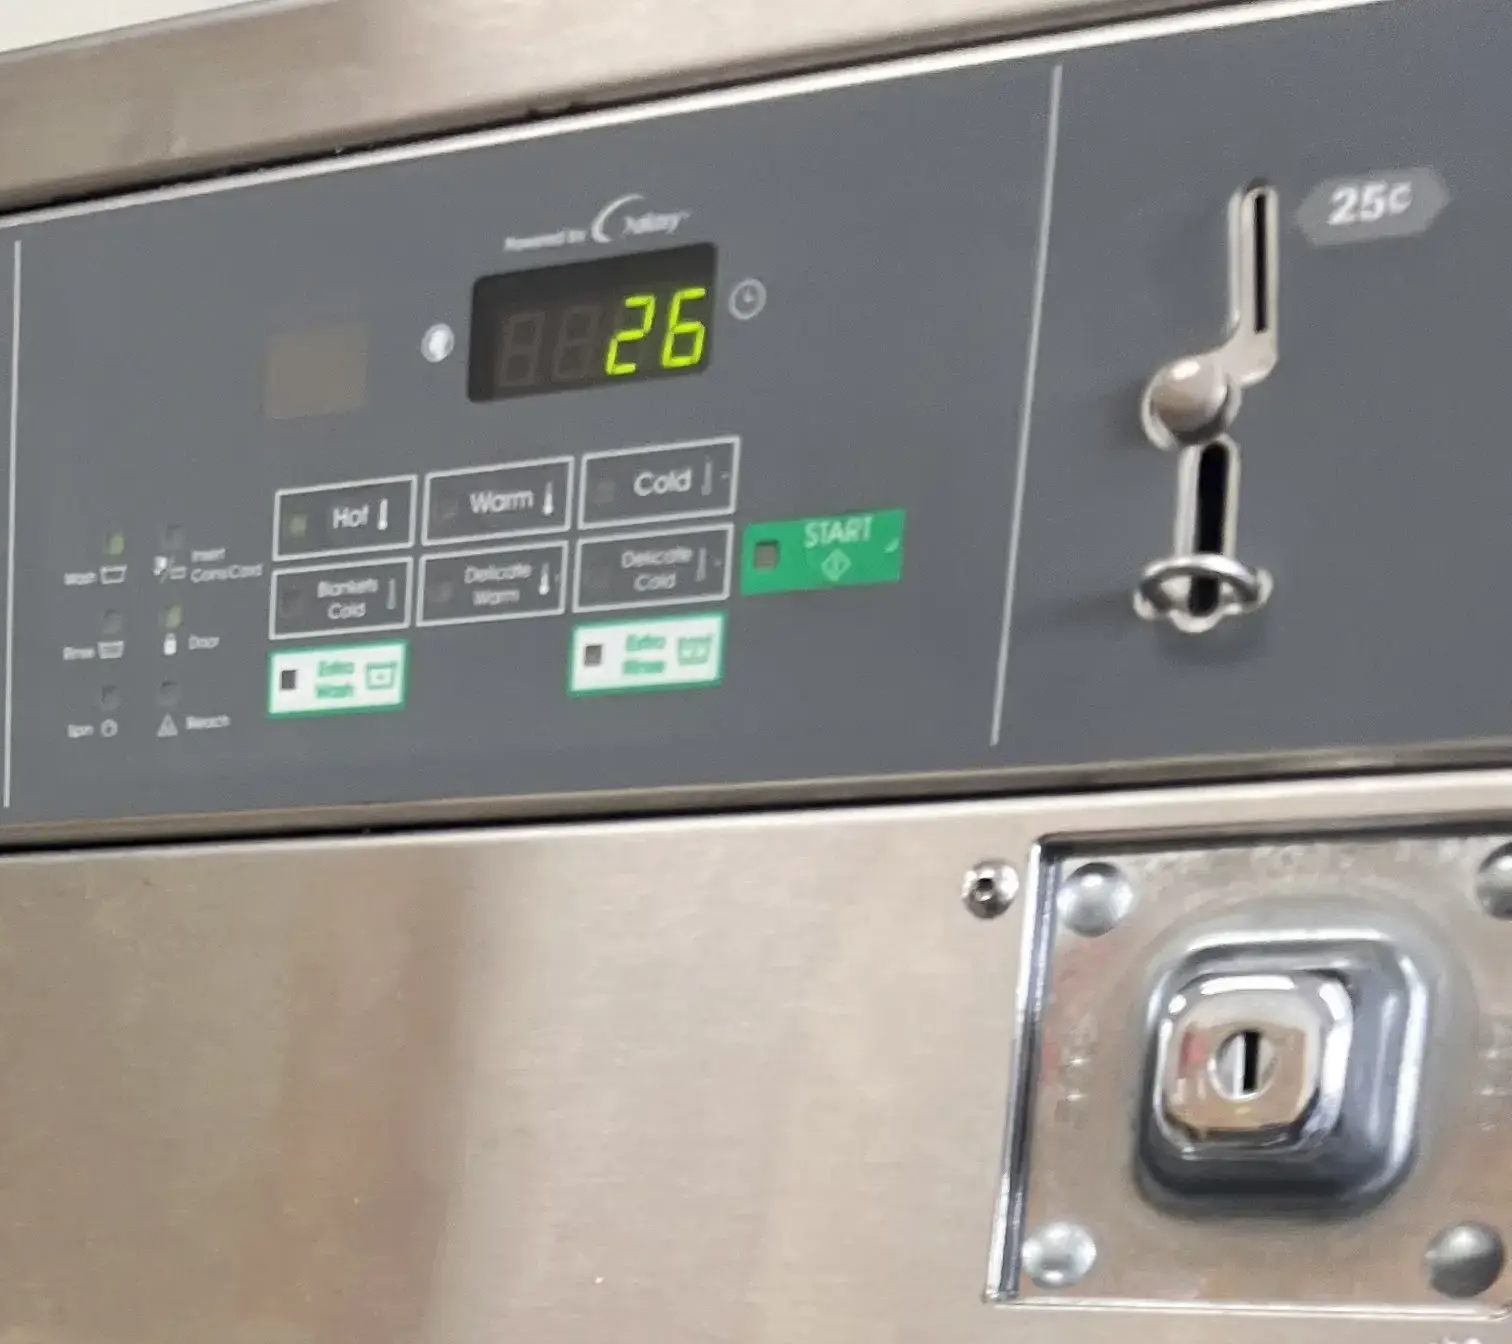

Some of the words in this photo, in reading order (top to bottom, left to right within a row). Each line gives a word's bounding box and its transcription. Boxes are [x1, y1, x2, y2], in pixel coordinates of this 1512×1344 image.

[605, 286, 706, 376] 26
[633, 467, 693, 497] Cold
[469, 490, 535, 514] Warm
[332, 505, 370, 529] Hot
[804, 515, 873, 549] START
[620, 546, 694, 569] Delicate
[463, 563, 532, 584] Delicate
[633, 572, 676, 592] Cold
[327, 601, 367, 620] Cold
